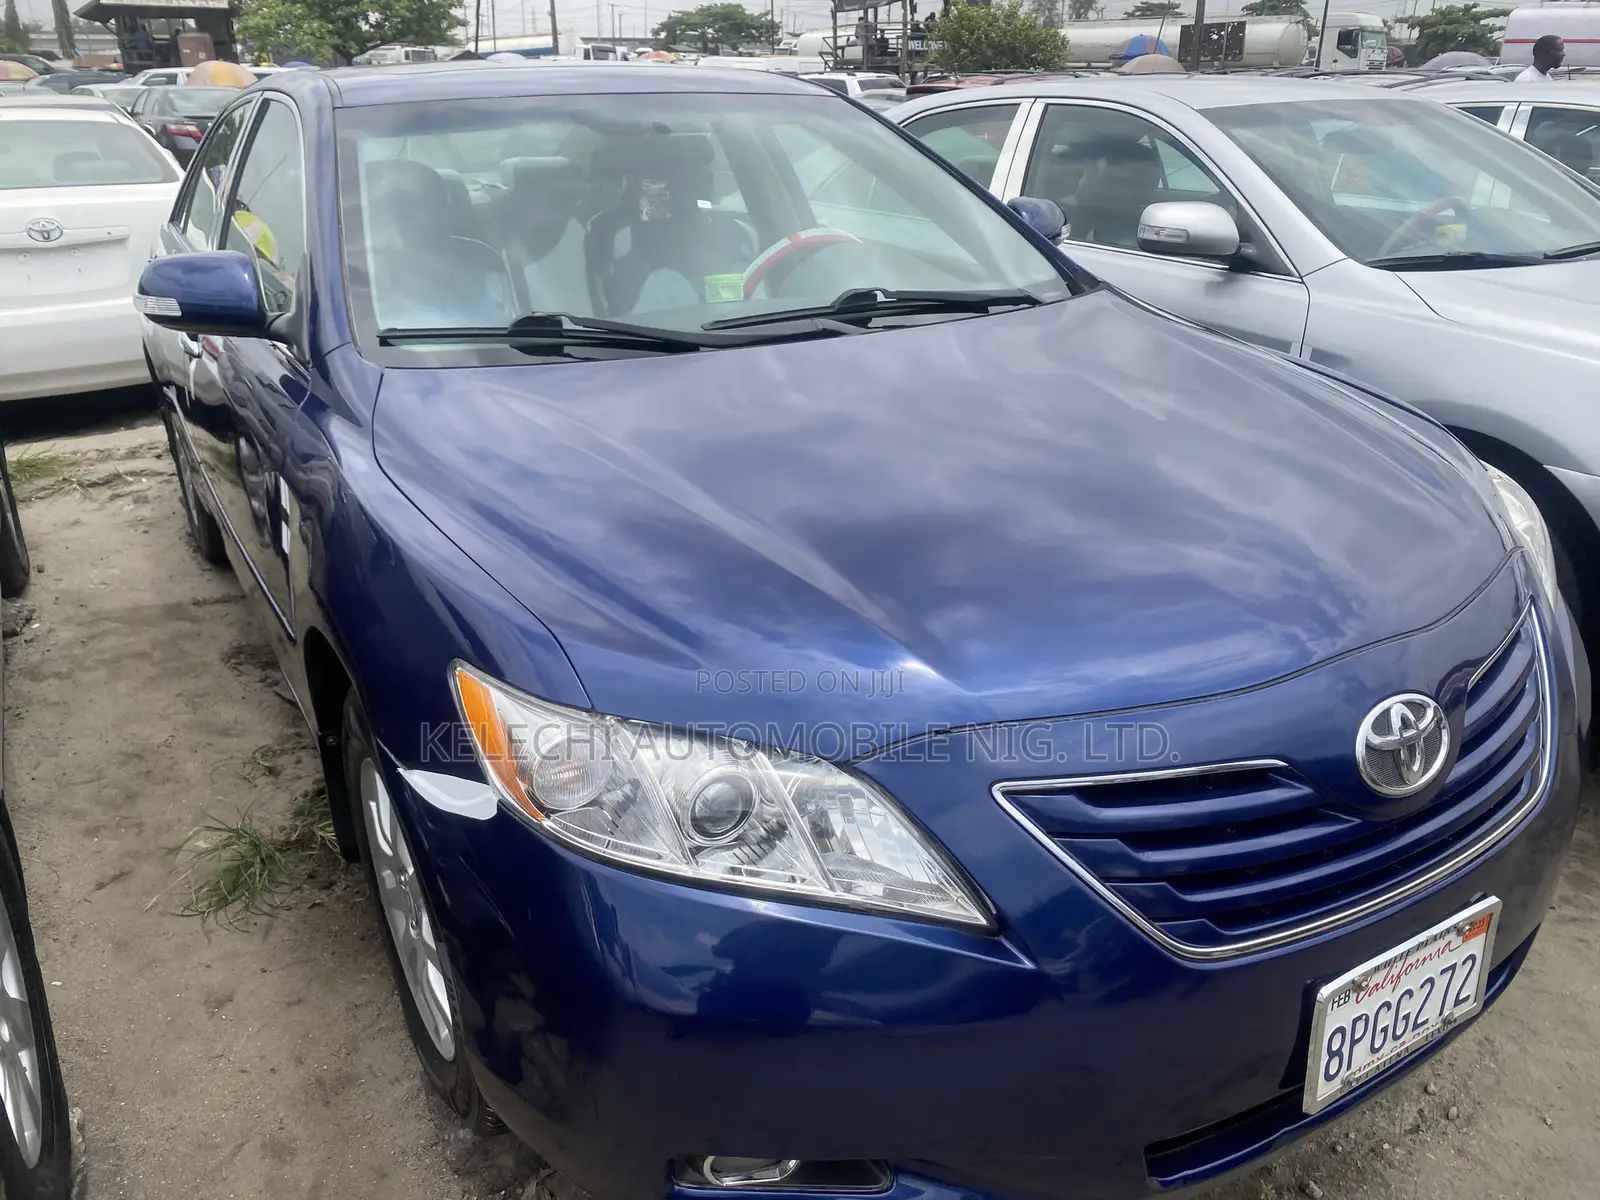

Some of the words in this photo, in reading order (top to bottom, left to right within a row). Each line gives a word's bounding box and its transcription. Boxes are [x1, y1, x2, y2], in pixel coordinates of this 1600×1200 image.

[1331, 989, 1351, 1011] FEB
[1355, 939, 1461, 1004] California
[1324, 953, 1477, 1082] 8PGG272
